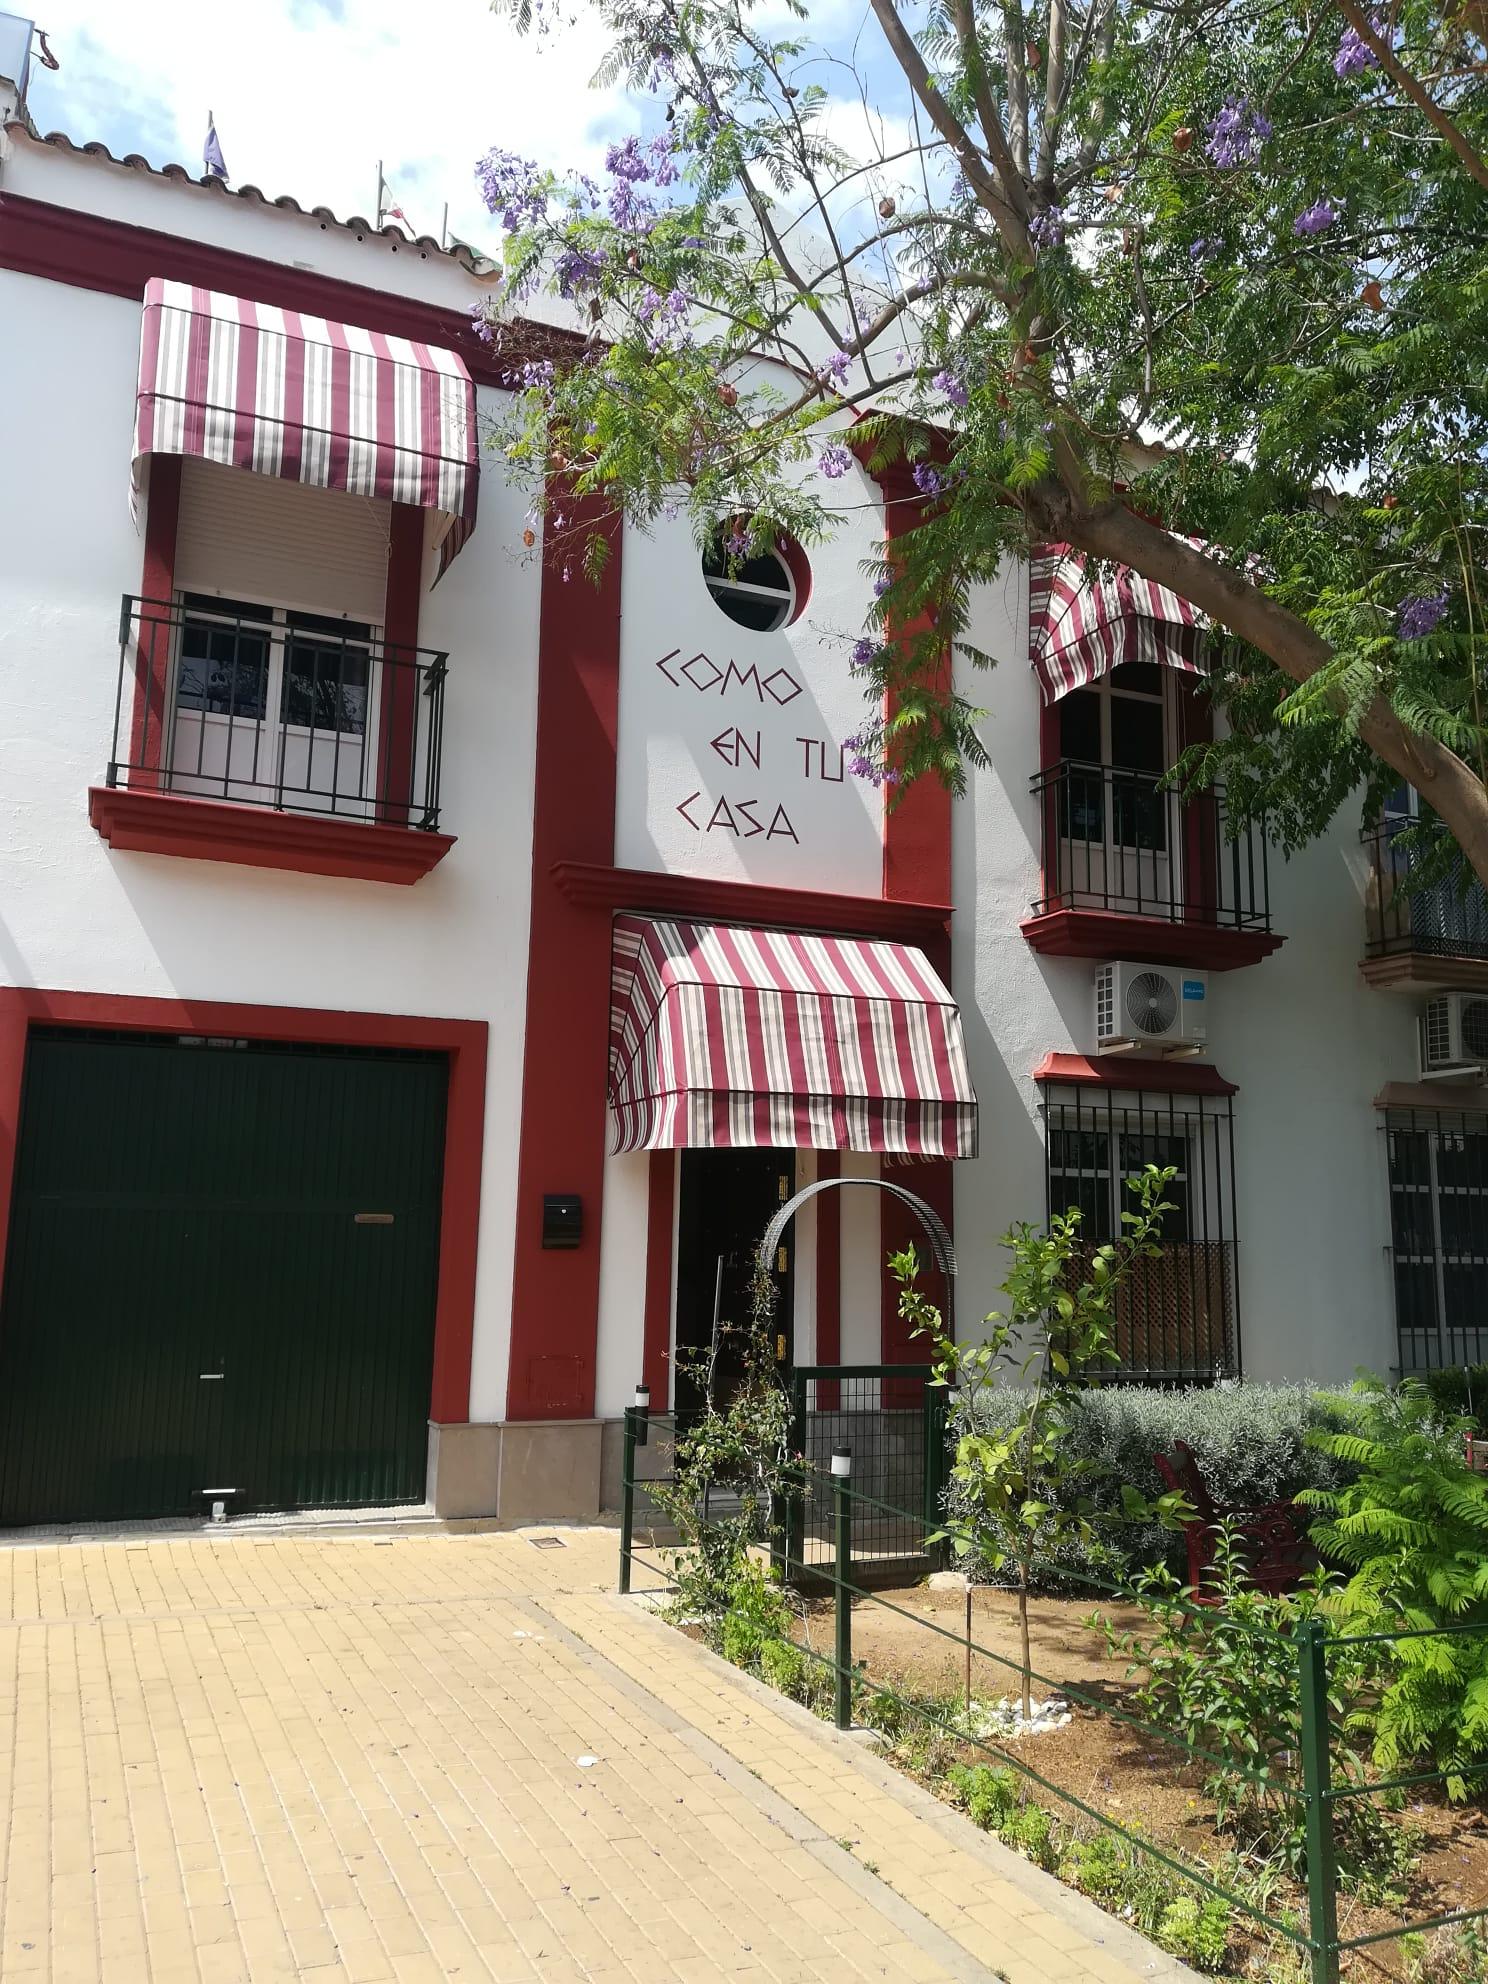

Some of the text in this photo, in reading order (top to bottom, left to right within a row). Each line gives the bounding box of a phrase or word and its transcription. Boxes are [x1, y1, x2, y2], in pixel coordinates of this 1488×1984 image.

[656, 649, 803, 706] COMO
[710, 727, 844, 782] EN TU
[676, 792, 800, 844] CASA
